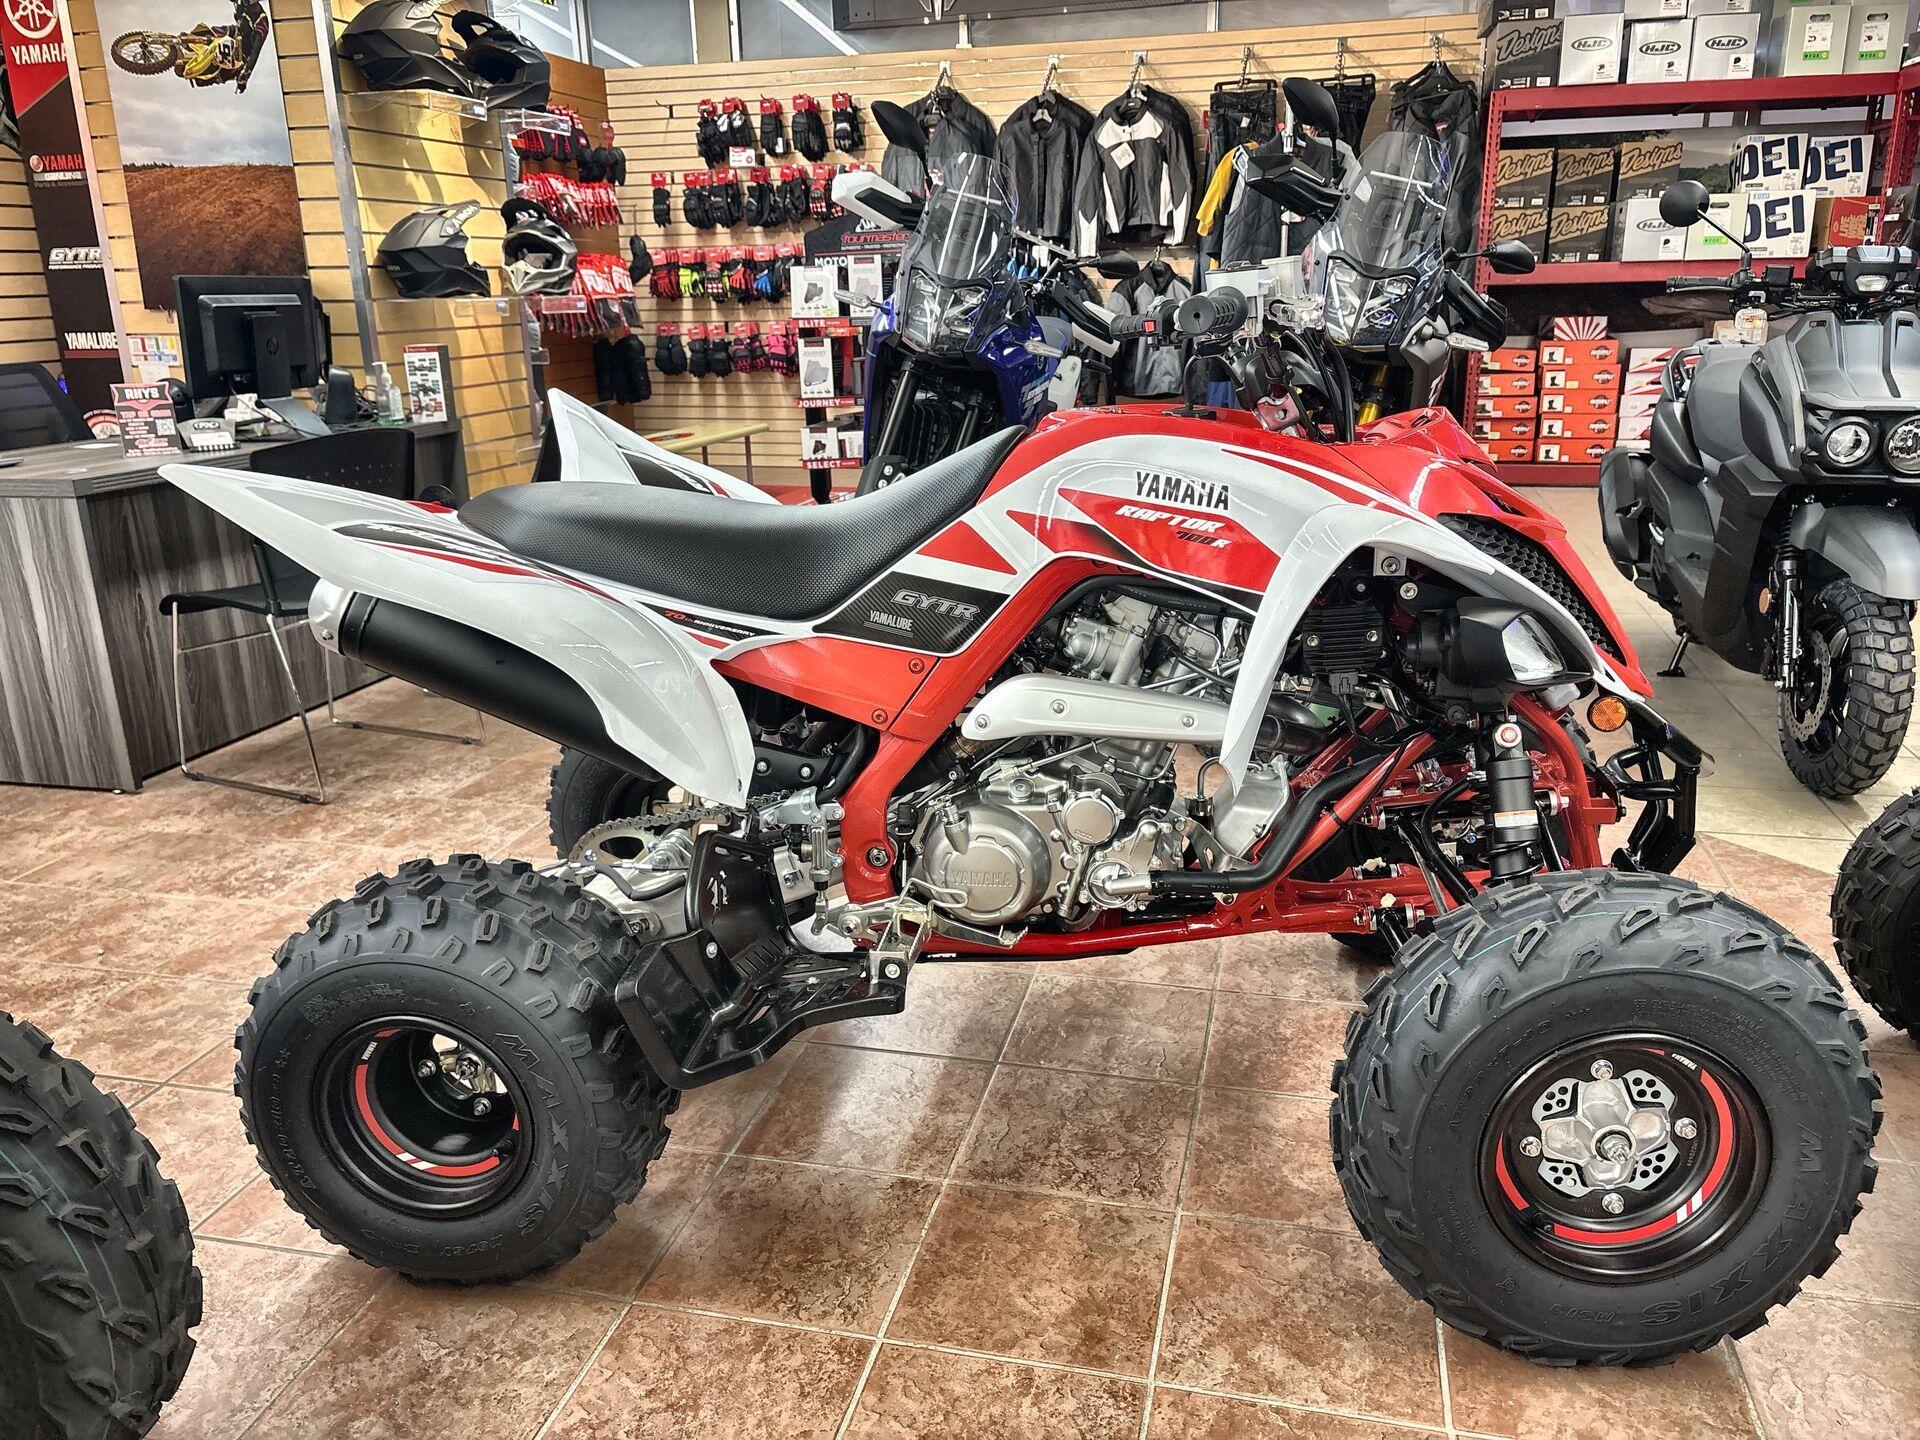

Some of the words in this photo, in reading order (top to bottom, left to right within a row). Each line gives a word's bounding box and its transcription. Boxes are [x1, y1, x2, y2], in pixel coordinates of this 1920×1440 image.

[1645, 44, 1676, 53] HJC
[1711, 40, 1743, 48] HJC
[42, 154, 83, 171] YAMAH
[1556, 149, 1616, 182] Designs
[1621, 142, 1683, 175] Designs
[1550, 207, 1609, 240] Designs
[843, 230, 911, 244] tourmaster
[49, 247, 102, 262] GYTR
[814, 256, 848, 267] MOTO
[798, 319, 826, 327] ELITE
[64, 332, 119, 349] YAMALUBE
[124, 387, 160, 400] RHYS
[798, 398, 841, 408] JOURNEY
[806, 460, 842, 469] SELECT
[1136, 471, 1230, 511] YAMAHA
[1115, 504, 1226, 533] RAPTOR
[1176, 530, 1232, 549] 700R
[890, 588, 981, 621] GYTR
[869, 609, 914, 632] YAMALUBE
[952, 870, 1014, 888] YAMAHA
[495, 1032, 569, 1235] MAXXIS
[1640, 1121, 1825, 1328] MAXXIS
